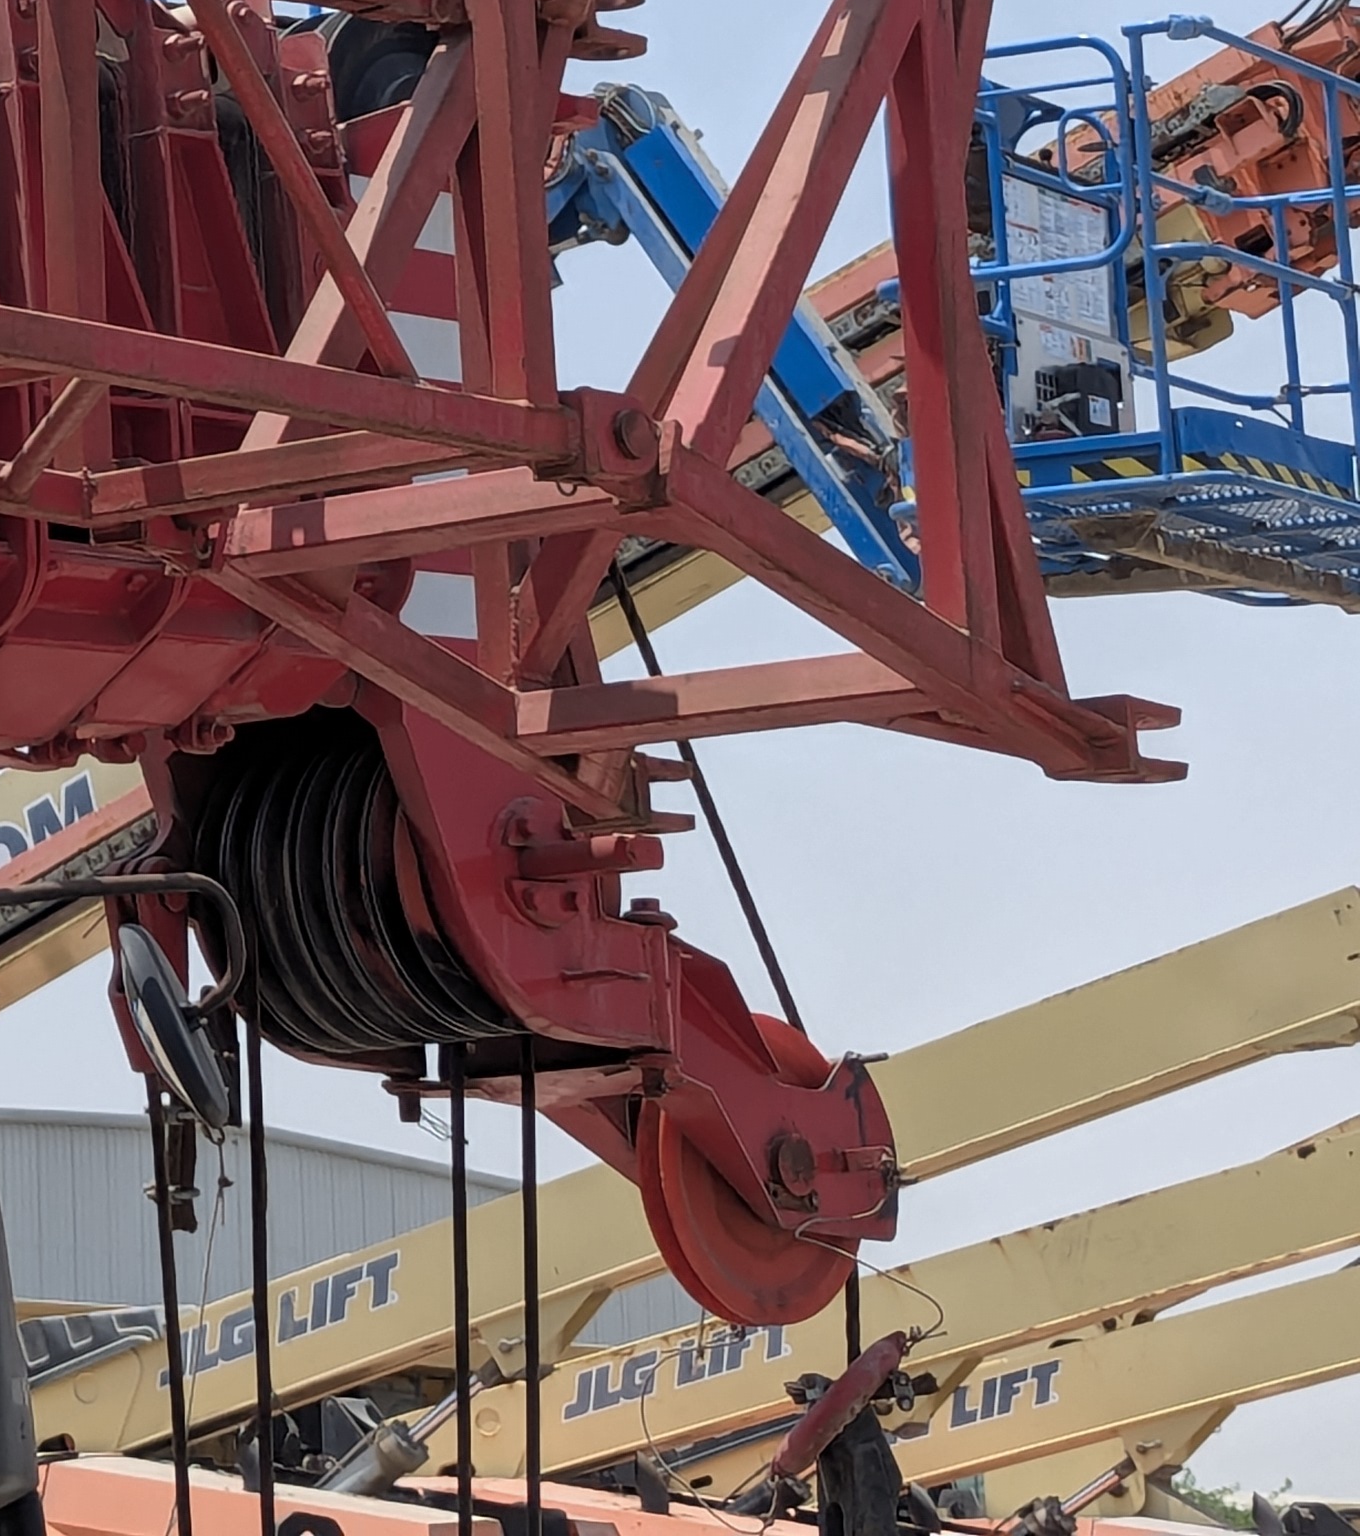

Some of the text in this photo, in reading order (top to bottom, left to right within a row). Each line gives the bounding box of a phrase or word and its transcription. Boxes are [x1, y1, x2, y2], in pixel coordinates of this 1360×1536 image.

[277, 1252, 399, 1345] LIFT
[562, 1350, 660, 1421] JLG
[950, 1360, 1059, 1429] LIFT
